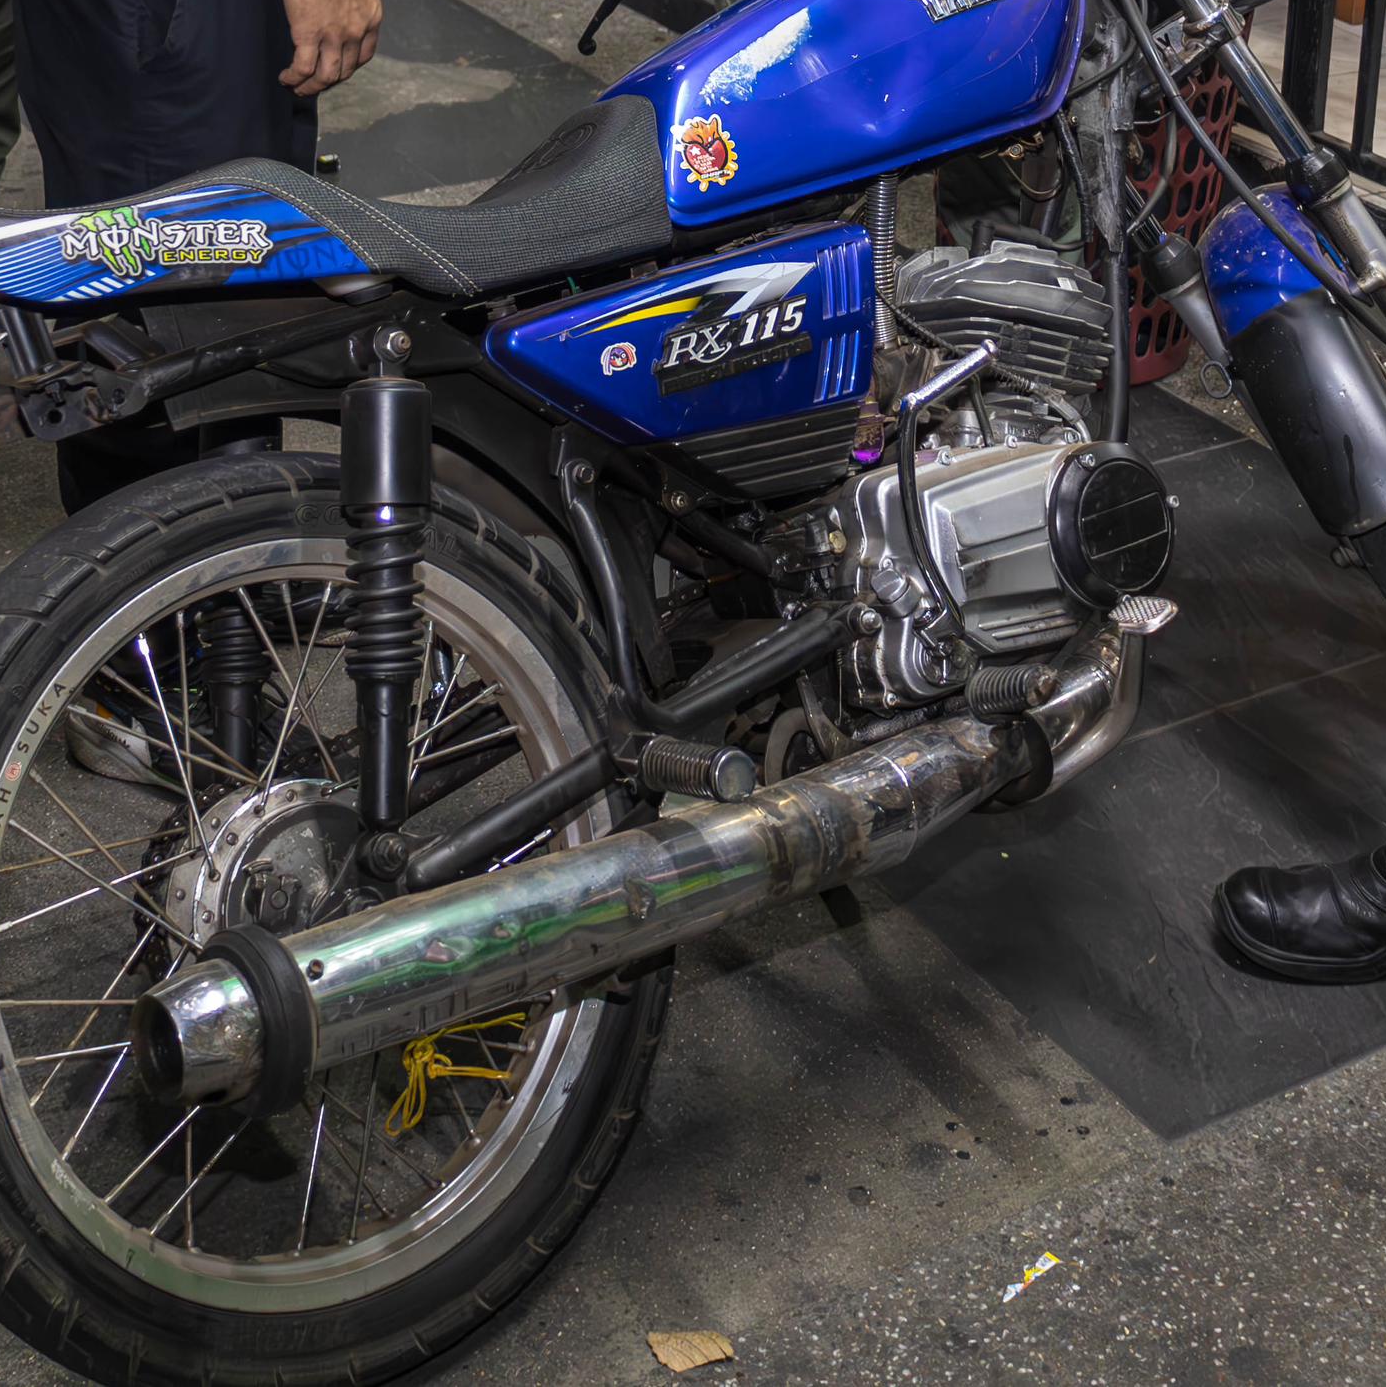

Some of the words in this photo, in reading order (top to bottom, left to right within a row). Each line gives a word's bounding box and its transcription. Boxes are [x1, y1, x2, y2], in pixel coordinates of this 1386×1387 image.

[63, 221, 271, 256] MONSTER
[162, 247, 264, 262] ENERGY
[662, 321, 732, 369] RX
[739, 298, 807, 347] 115
